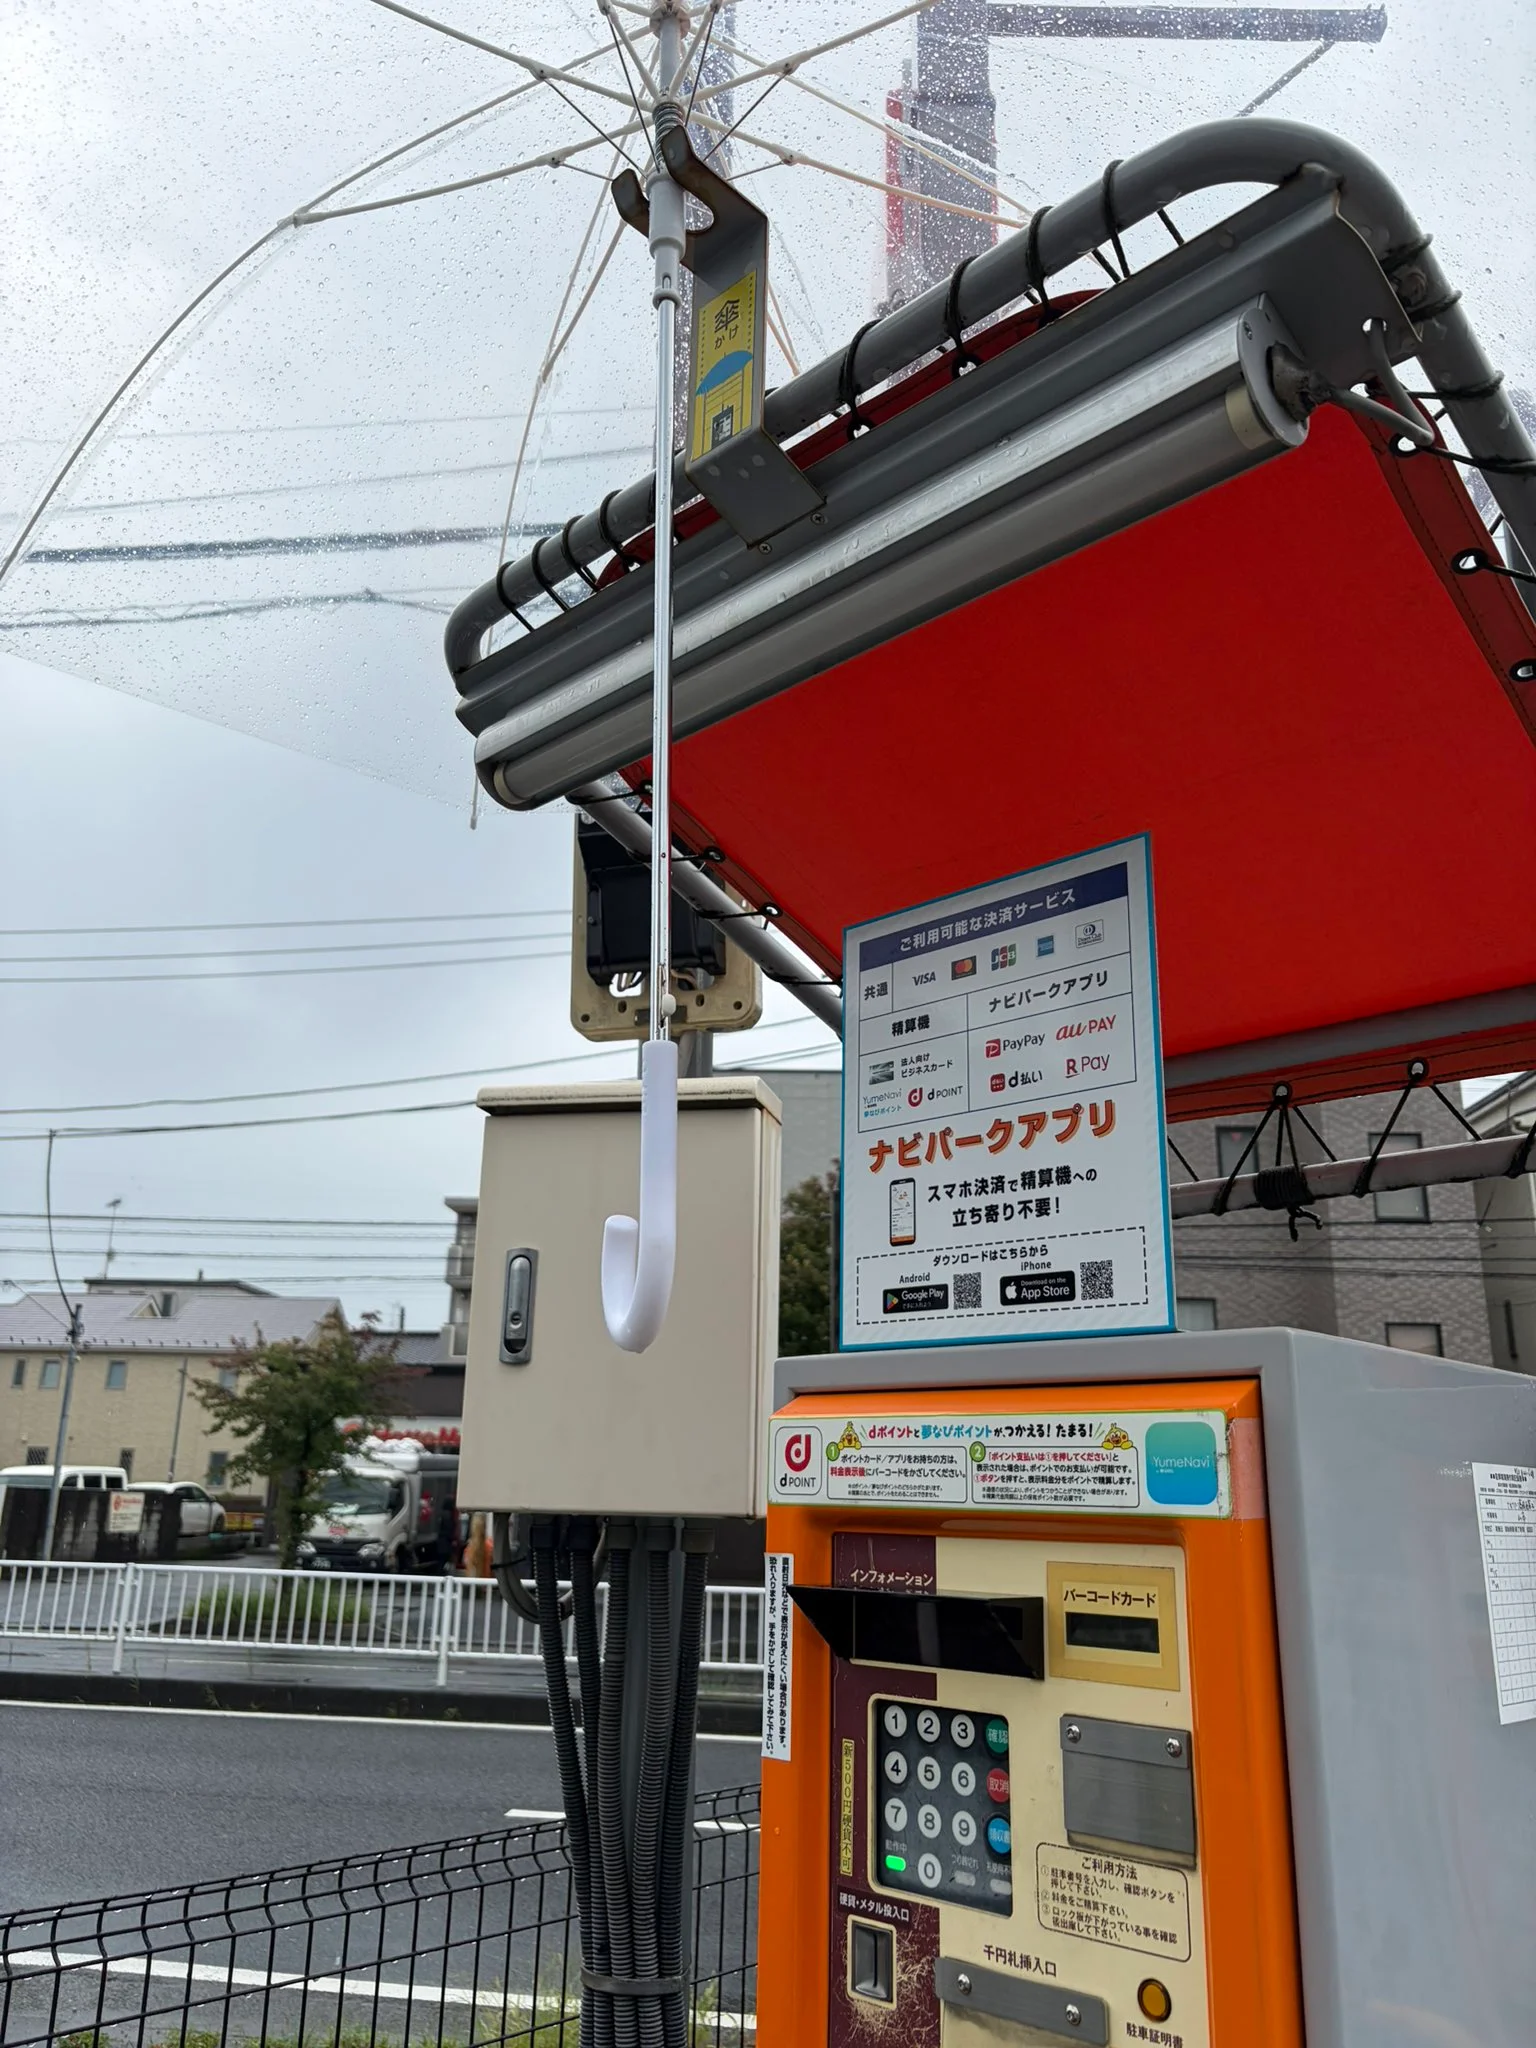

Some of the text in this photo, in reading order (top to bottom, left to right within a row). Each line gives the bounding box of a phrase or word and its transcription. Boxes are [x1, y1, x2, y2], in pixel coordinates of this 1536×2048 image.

[714, 299, 740, 334] 傘
[714, 325, 739, 350] かけ
[900, 887, 1076, 952] ご利用可能な決済サービス
[991, 946, 1016, 967] JCB
[912, 971, 936, 986] VISA
[864, 981, 889, 1000] 共通
[989, 970, 1109, 1013] ナビパークアプリ
[892, 1014, 930, 1037] 精算機
[1056, 1014, 1117, 1040] au PAY
[1003, 1033, 1046, 1051] PayPay
[901, 1053, 930, 1067] 法人向け
[901, 1059, 953, 1078] ビジネスカード
[1081, 1054, 1110, 1072] Pay
[1008, 1070, 1043, 1088] d払い
[863, 1088, 902, 1104] YumeNavi
[936, 1085, 963, 1099] POINT
[868, 1099, 1117, 1174] ナビパークアプリ
[927, 1165, 1097, 1203] スマホ決済で精算機への
[952, 1196, 1061, 1228] 立ち寄り不要！
[933, 1244, 1049, 1267] ダウンロードはこちらから
[1020, 1260, 1052, 1271] iPhone
[899, 1272, 931, 1284] Android
[1020, 1278, 1048, 1286] Download
[901, 1287, 945, 1301] Google Play
[1020, 1285, 1070, 1300] App Store
[1153, 1455, 1210, 1469] YumeNavi
[830, 1466, 966, 1479] 料金表示後にバーコードをかざしてください。
[789, 1476, 816, 1488] POINT
[850, 1568, 934, 1587] インフォメーション
[1063, 1588, 1157, 1608] バーコードカード
[891, 1713, 898, 1730] 1
[923, 1717, 934, 1735] 2
[957, 1722, 968, 1740] 3
[987, 1728, 1008, 1744] 確認
[891, 1759, 902, 1776] 4
[924, 1764, 935, 1782] 5
[957, 1770, 969, 1788] 6
[890, 1805, 902, 1823] 7
[924, 1812, 935, 1830] 8
[958, 1819, 970, 1837] 9
[924, 1861, 935, 1880] 0
[1081, 1856, 1138, 1880] ご利用方法
[1051, 1867, 1176, 1904] 駐車番号を入力し、確認ボタンを
[839, 1892, 910, 1922] 硬貨・メタル投入口
[1052, 1906, 1178, 1945] ロック板が下がっている事を確認
[983, 1944, 1057, 1978] 千円札挿入口
[1125, 2022, 1184, 2048] 駐車証明書
